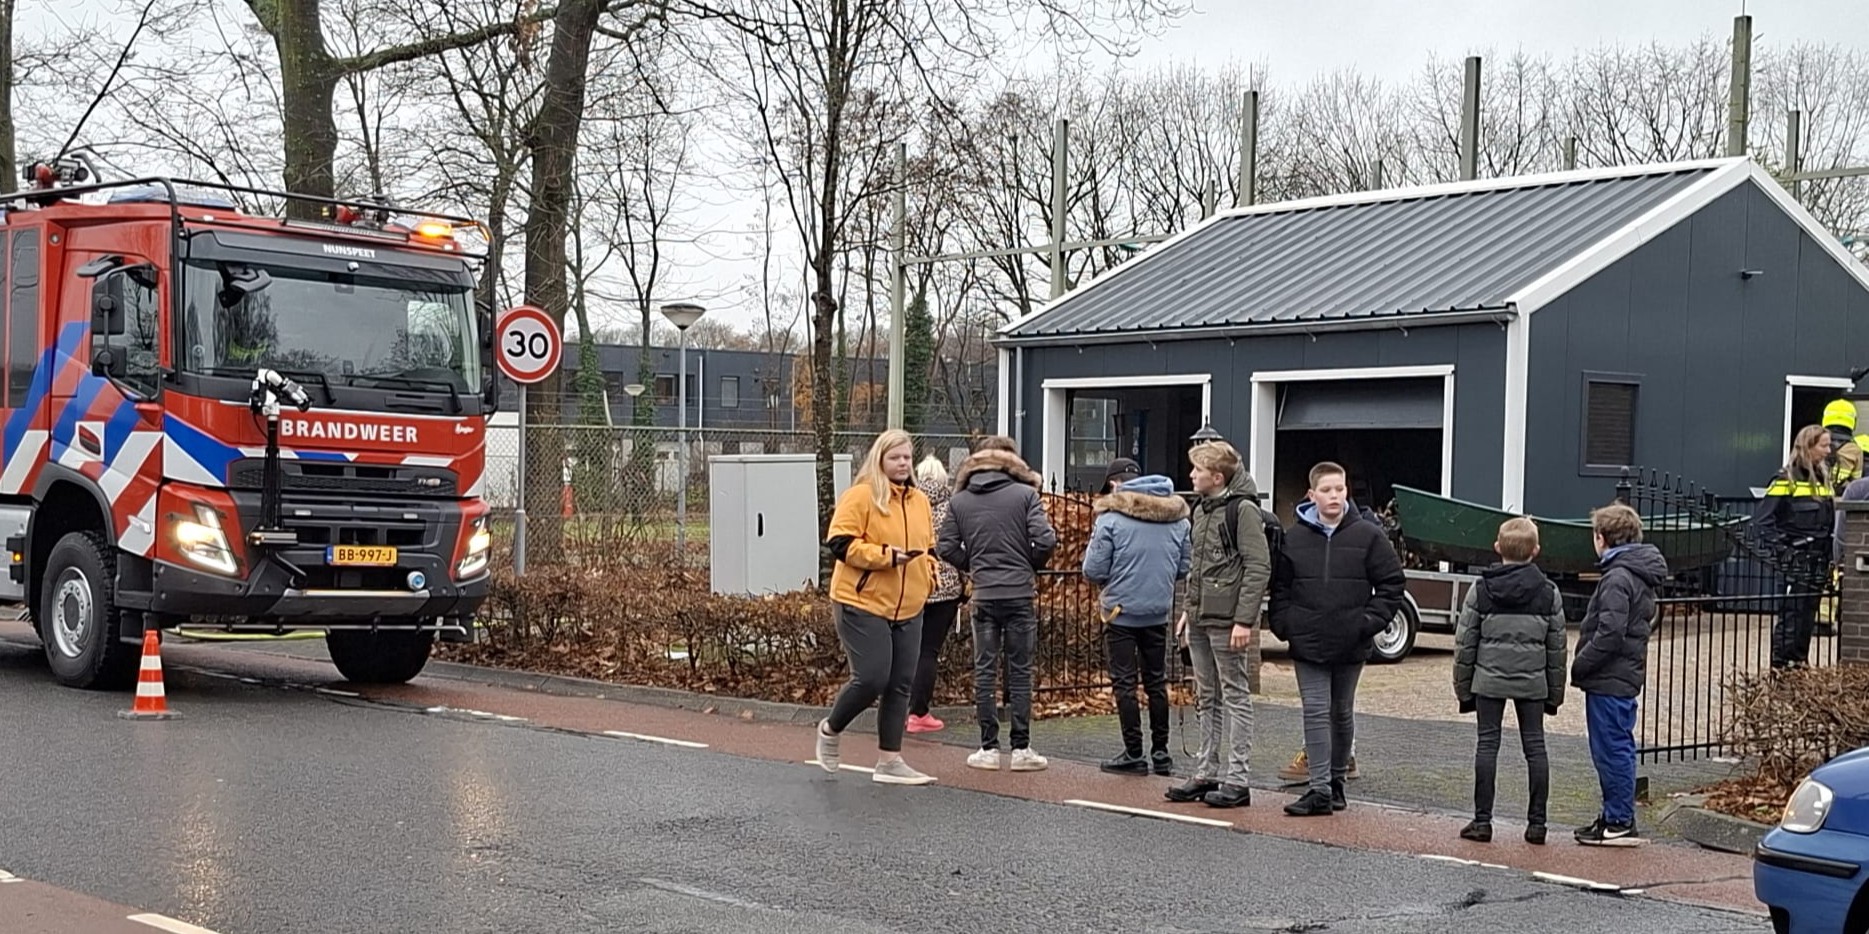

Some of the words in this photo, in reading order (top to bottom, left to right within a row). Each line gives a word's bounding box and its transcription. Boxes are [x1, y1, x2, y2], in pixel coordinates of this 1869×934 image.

[323, 244, 376, 258] NUNSPEET
[506, 330, 549, 360] 30
[281, 419, 418, 443] BRANDWEER
[338, 548, 393, 562] BB-997-J
